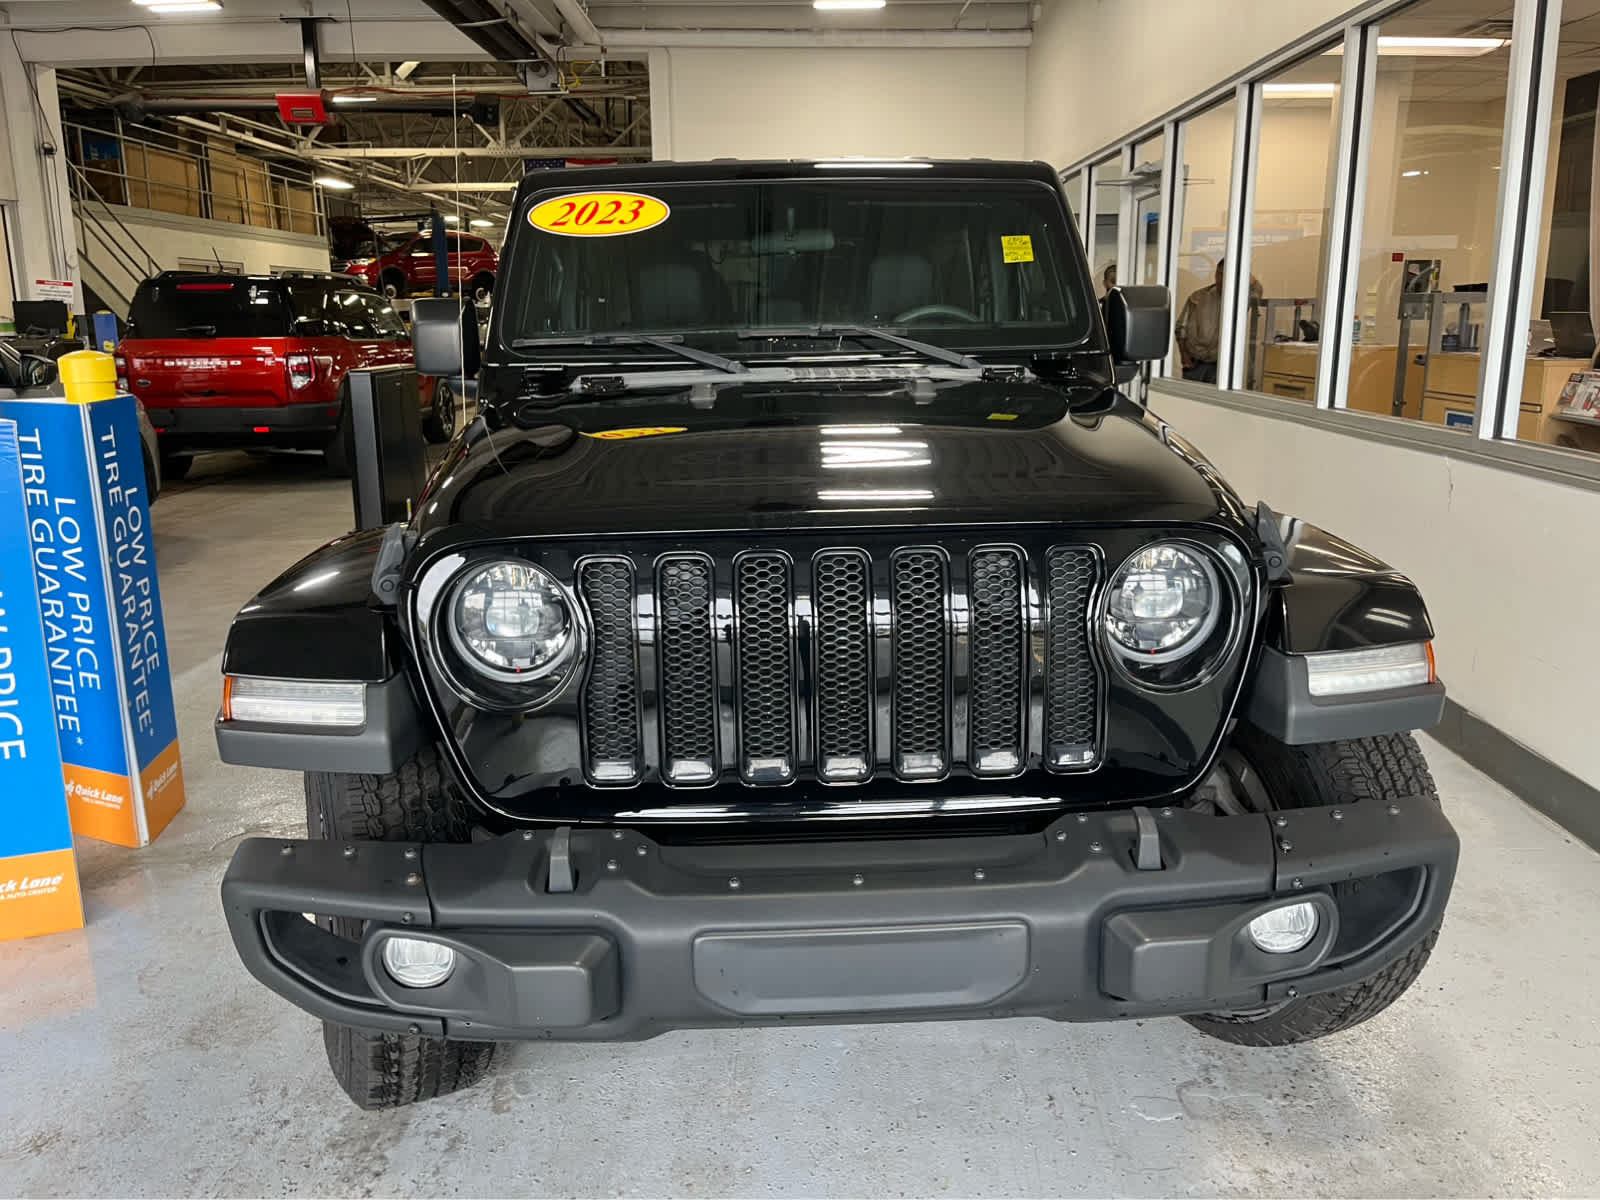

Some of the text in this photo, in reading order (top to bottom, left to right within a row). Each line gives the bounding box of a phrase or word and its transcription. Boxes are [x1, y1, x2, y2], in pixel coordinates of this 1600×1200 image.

[549, 199, 646, 227] 2023
[19, 428, 49, 507] TIRE
[101, 424, 123, 507] TIRE
[54, 497, 101, 690] LOW PRICE
[125, 487, 160, 674] LOW PRICE
[75, 784, 100, 798] Quick
[101, 790, 123, 803] Lane
[20, 876, 63, 889] Lane
